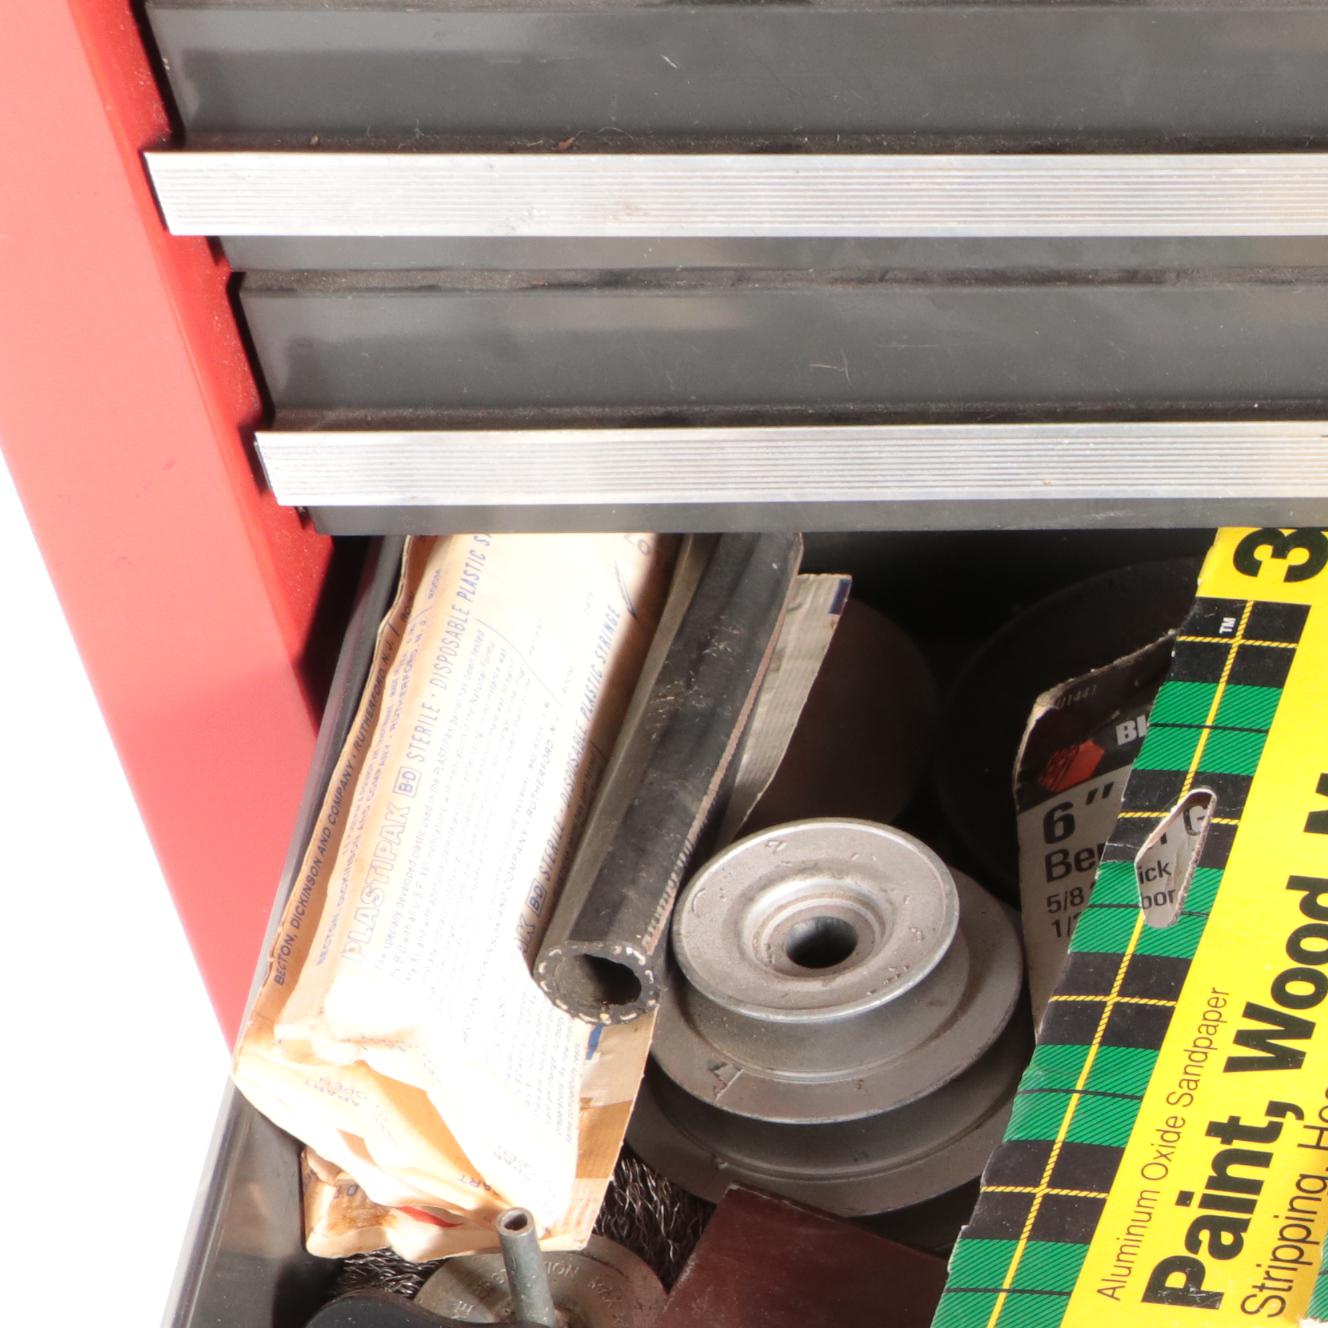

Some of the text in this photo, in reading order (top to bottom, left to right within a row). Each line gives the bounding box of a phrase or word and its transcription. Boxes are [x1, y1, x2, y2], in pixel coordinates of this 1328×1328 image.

[587, 603, 626, 664] SYRINGE
[1219, 616, 1237, 634] TM
[572, 665, 609, 721] PLASTIC
[341, 797, 412, 965] PLASTIPAK
[404, 699, 443, 763] STERILE
[427, 602, 473, 690] DISPOSABLE
[454, 546, 488, 602] PLASTIC
[287, 855, 324, 929] DICKINSON
[314, 825, 334, 855] AND
[325, 758, 358, 823] COMPANY
[1044, 842, 1106, 883] Be
[1097, 986, 1229, 1300] Aluminum Oxide Sandpaper
[1141, 1100, 1305, 1310] Paint,
